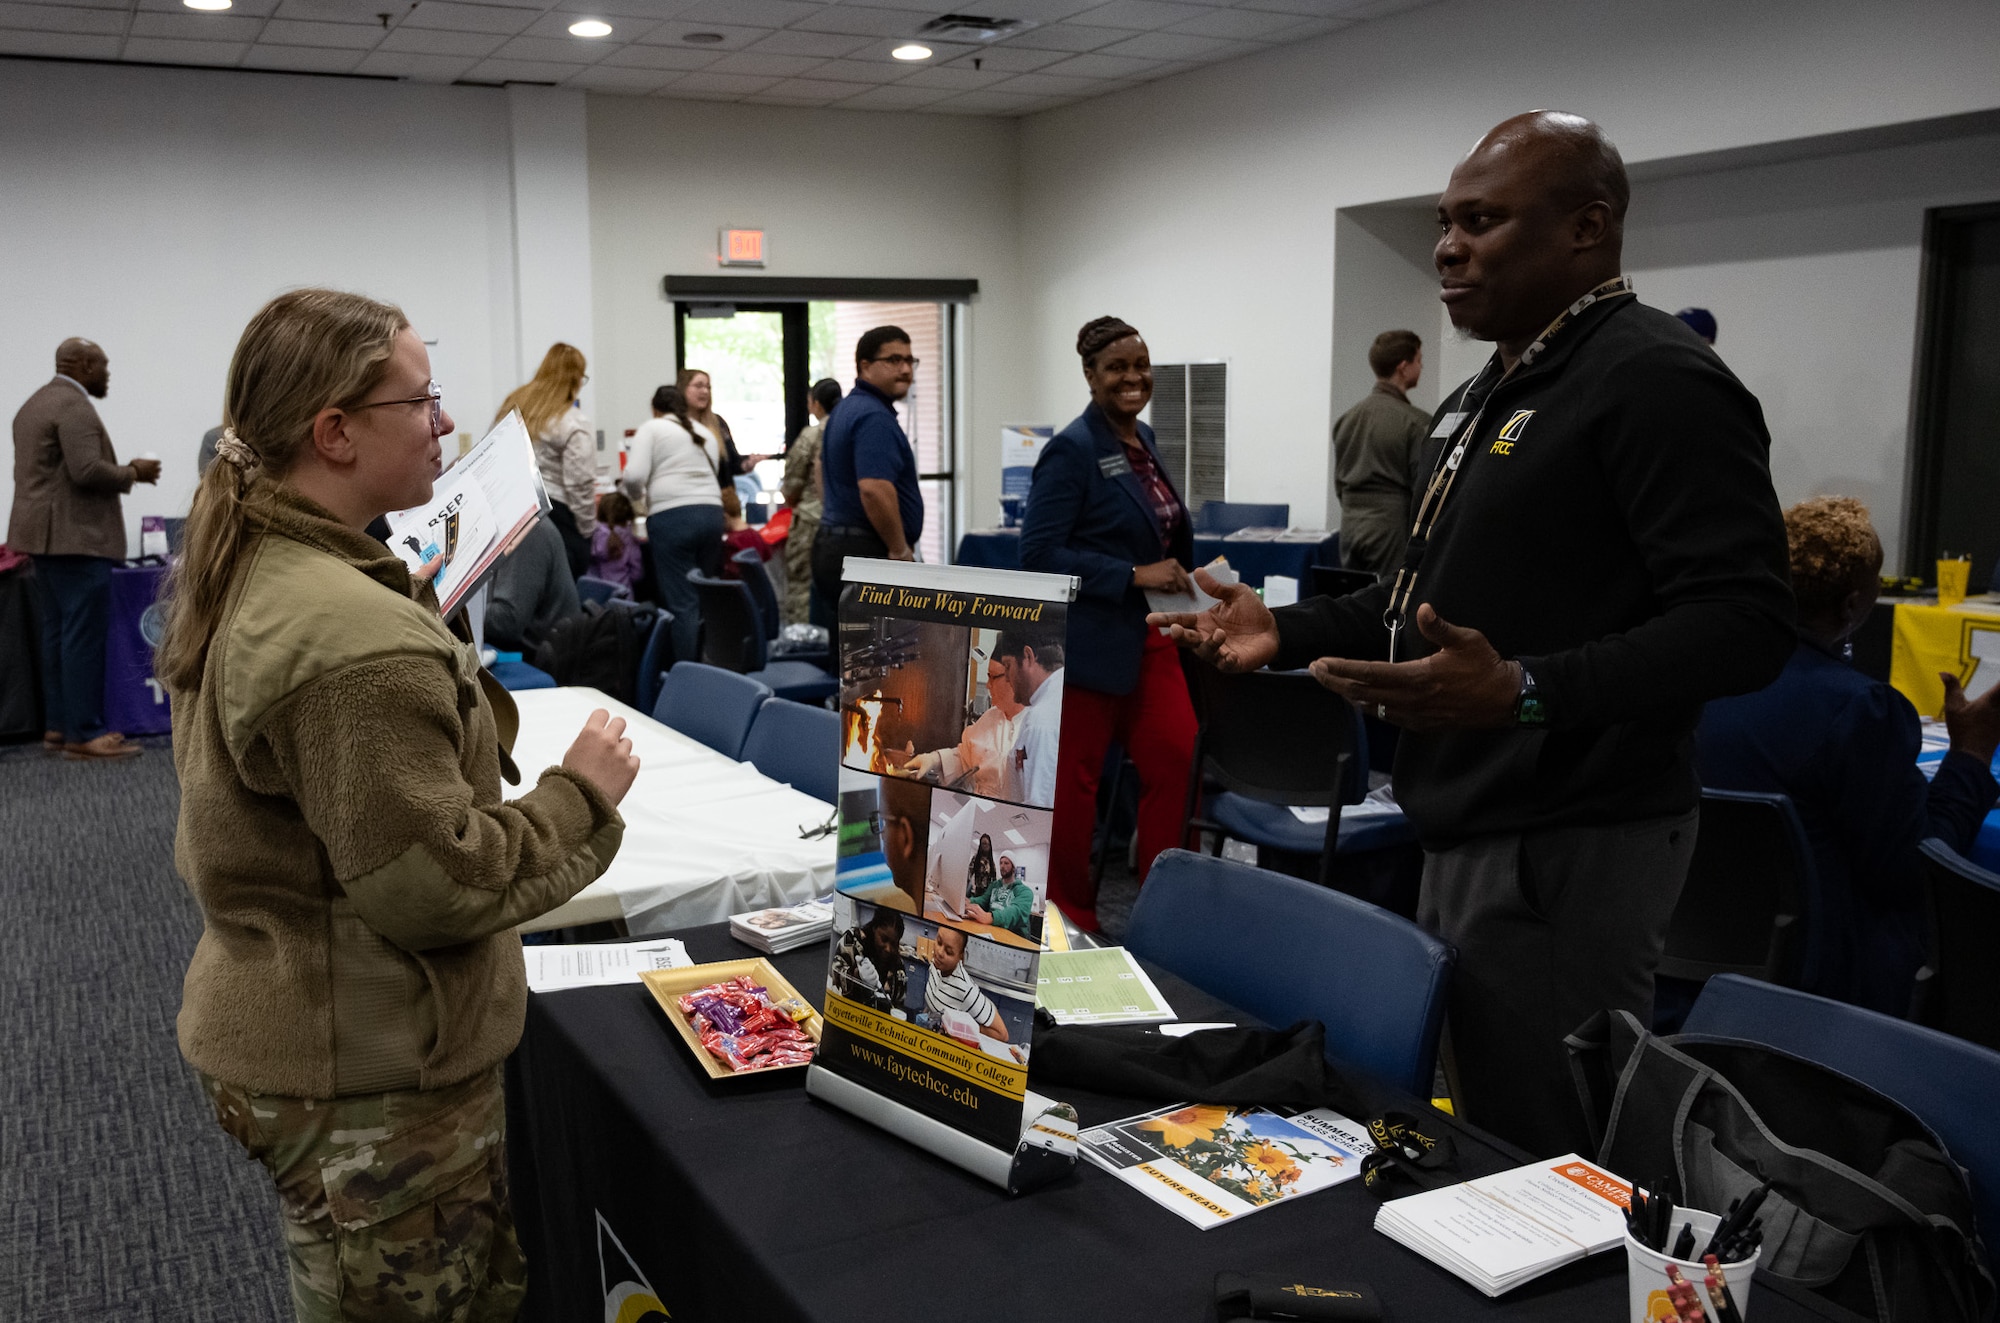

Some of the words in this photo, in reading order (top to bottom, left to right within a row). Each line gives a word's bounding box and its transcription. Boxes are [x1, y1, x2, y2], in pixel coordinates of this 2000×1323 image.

[1490, 441, 1514, 455] FTCC
[858, 585, 894, 606] Find
[897, 588, 930, 609] Your
[934, 592, 966, 618] Way
[970, 596, 1044, 622] Forward
[828, 1002, 873, 1029] Fayetteville
[875, 1020, 918, 1046] Technical
[919, 1039, 974, 1072] Community
[975, 1062, 1015, 1087] College
[851, 1042, 980, 1110] www.faytechcc.edu
[1296, 1119, 1328, 1135] CLASS
[1303, 1114, 1359, 1142] SUMMER
[1142, 1165, 1186, 1191] FUTURE
[1186, 1192, 1230, 1217] READY!
[1586, 1175, 1631, 1202] CAMPB
[1586, 1180, 1631, 1206] UNIVERSI
